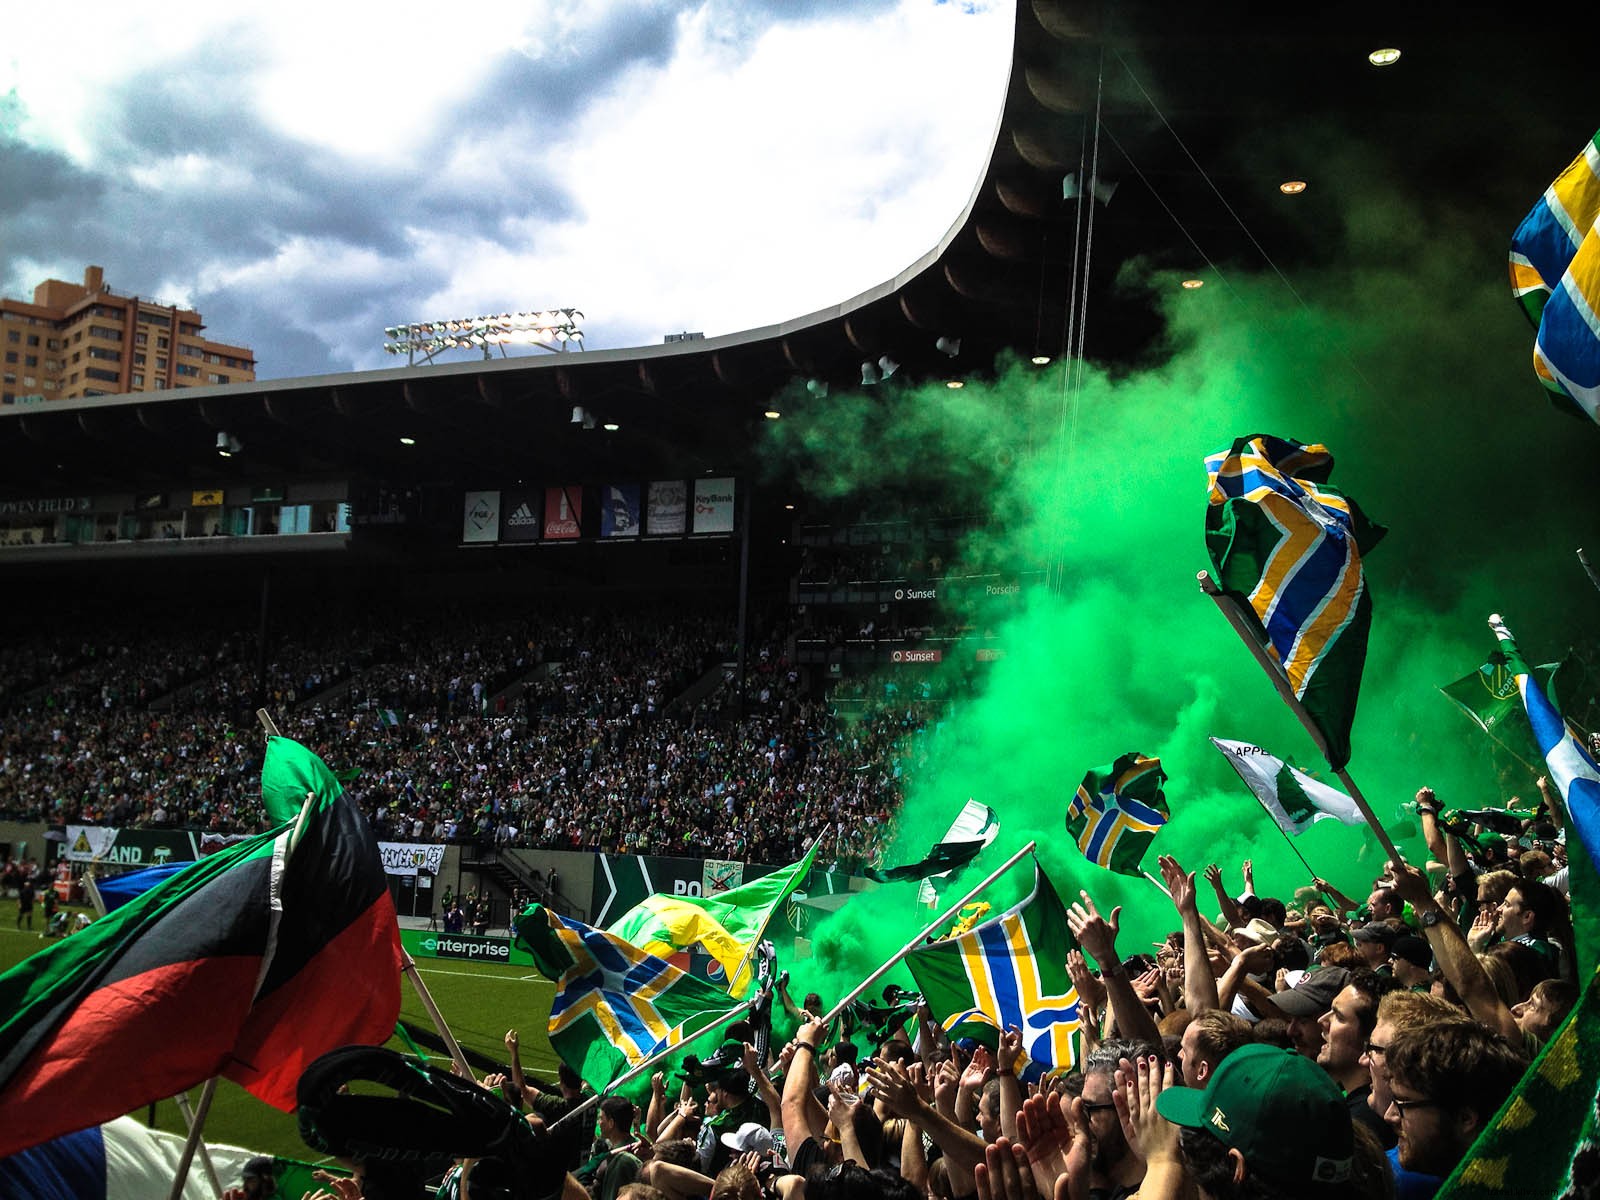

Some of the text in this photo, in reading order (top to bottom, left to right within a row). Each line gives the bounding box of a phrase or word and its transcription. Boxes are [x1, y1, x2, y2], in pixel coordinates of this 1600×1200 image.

[38, 498, 75, 513] FIELD
[695, 494, 733, 505] KeyBank
[508, 517, 536, 526] adidas
[906, 588, 936, 600] Sunset
[986, 584, 1021, 596] Porsche
[905, 650, 935, 662] Sunset
[419, 938, 509, 957] enterprise
